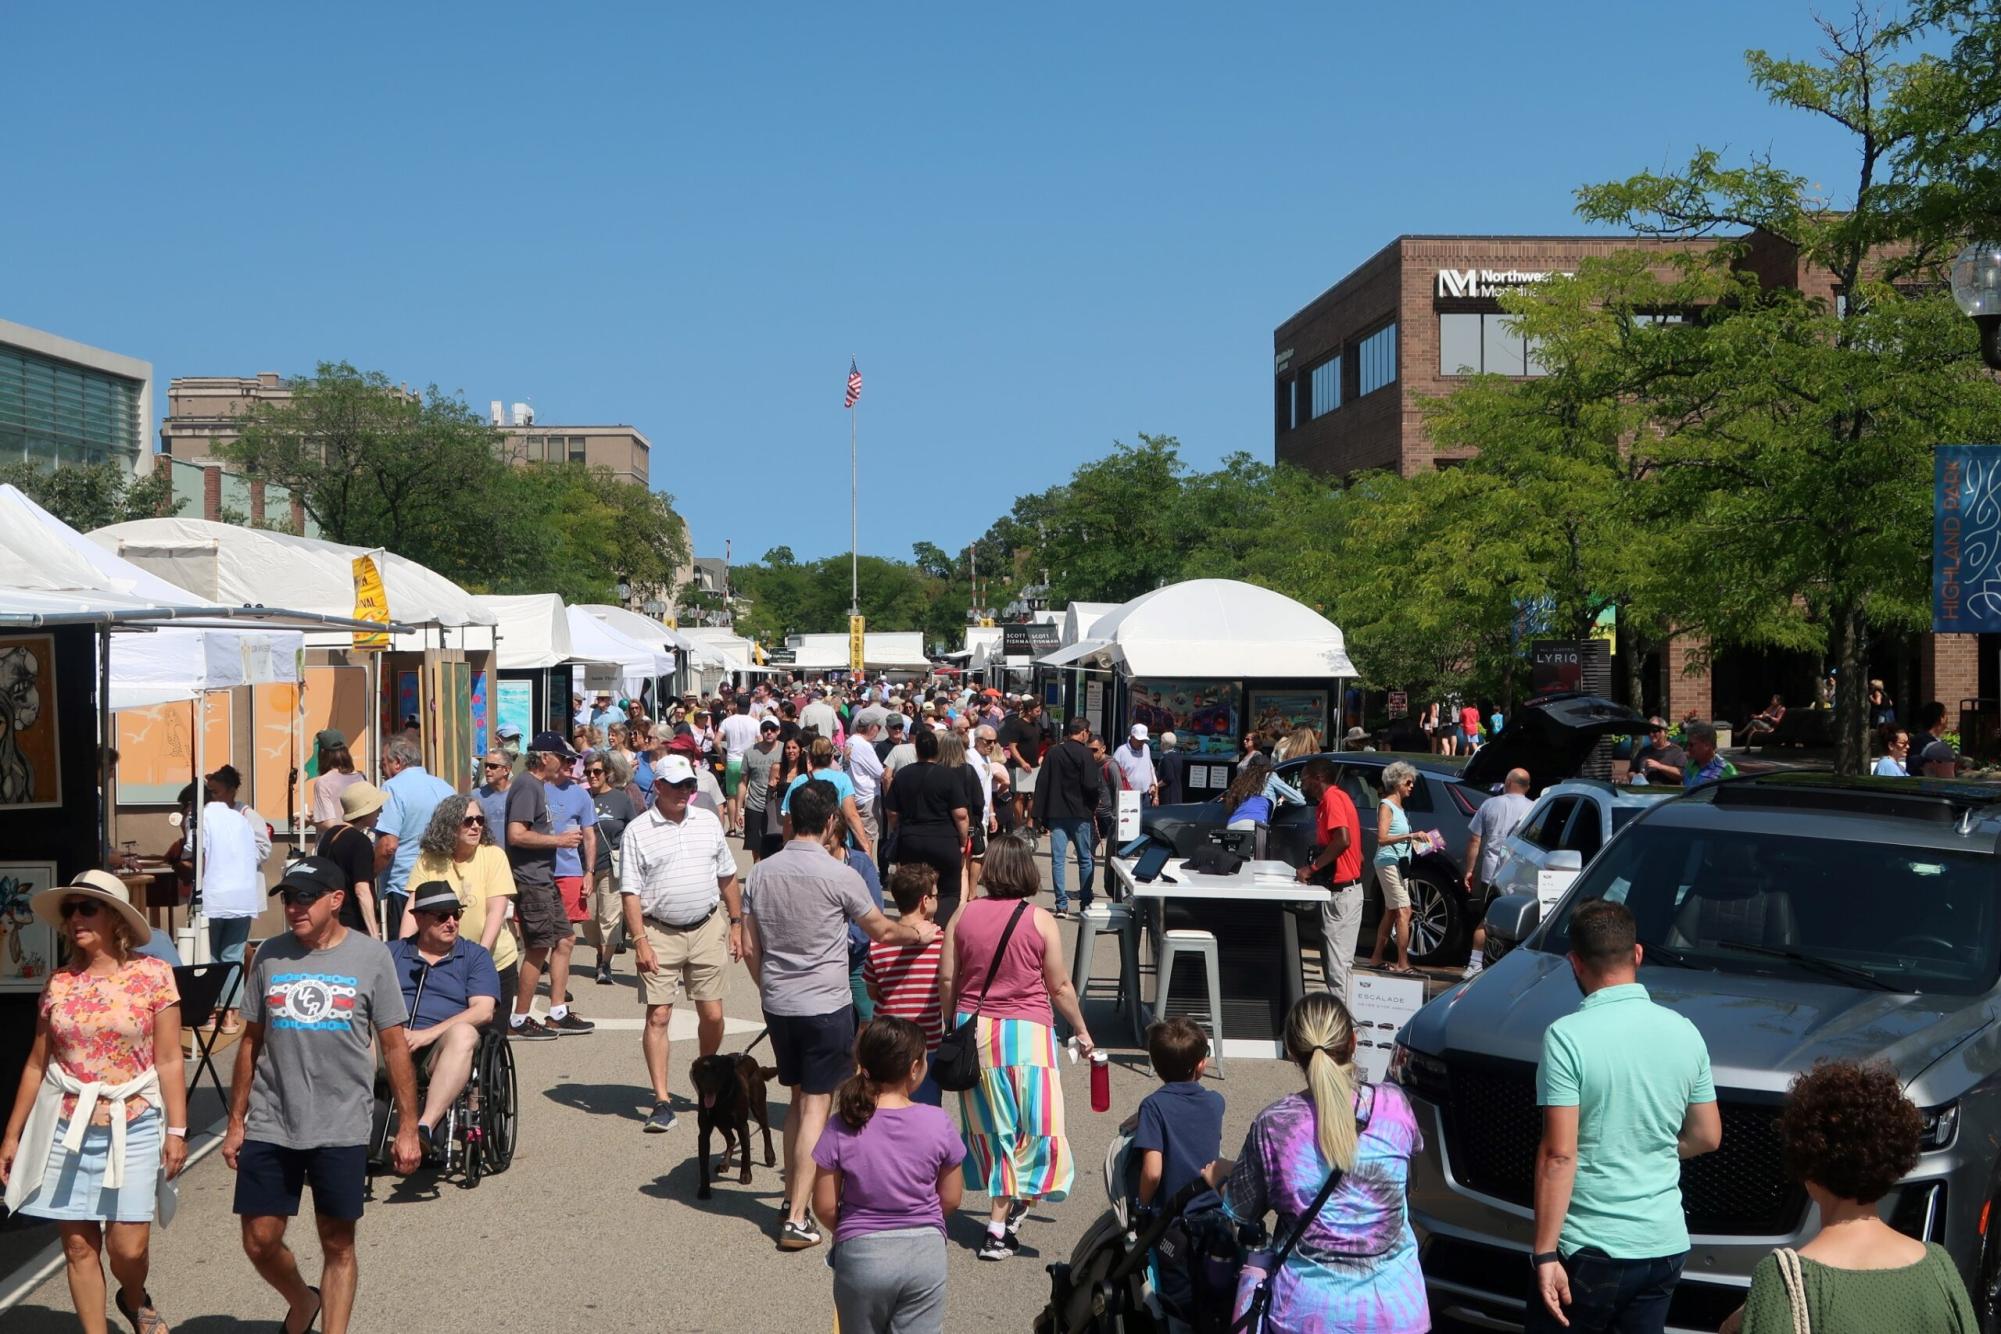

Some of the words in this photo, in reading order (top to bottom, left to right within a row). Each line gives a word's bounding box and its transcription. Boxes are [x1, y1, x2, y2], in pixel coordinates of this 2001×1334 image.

[1943, 459, 1961, 510] PARK
[1941, 516, 1961, 620] HIGHLAND
[1536, 653, 1578, 664] LYRIQ
[298, 987, 321, 1015] VCR
[1358, 993, 1405, 1004] ESCALADE
